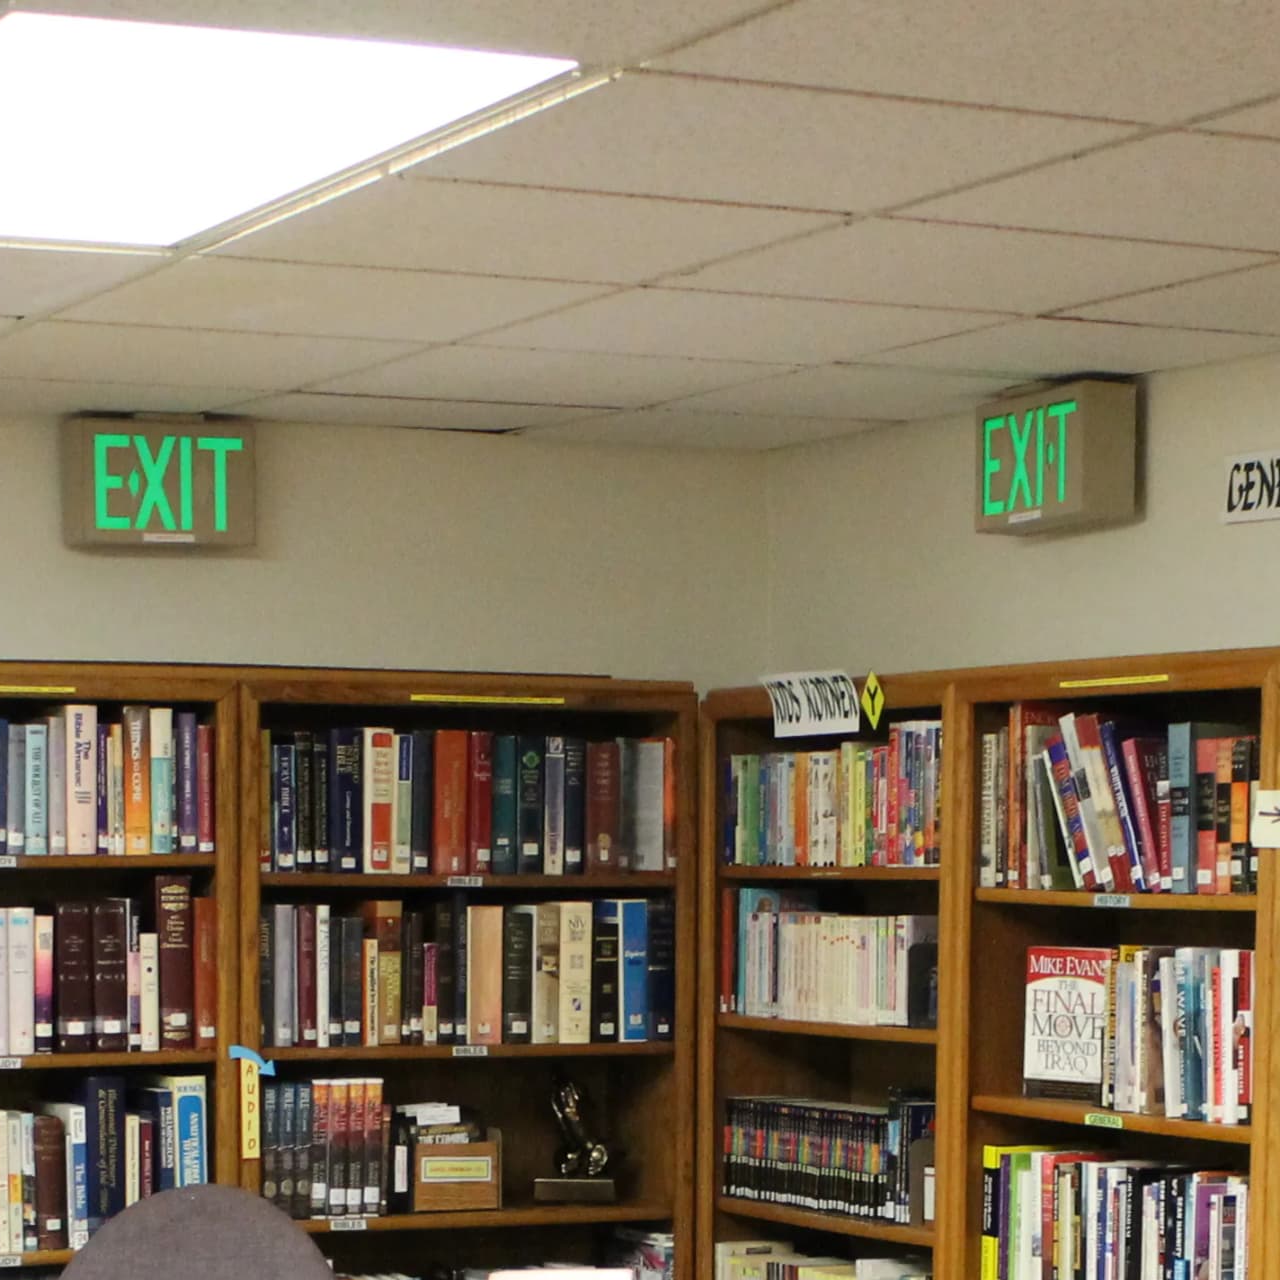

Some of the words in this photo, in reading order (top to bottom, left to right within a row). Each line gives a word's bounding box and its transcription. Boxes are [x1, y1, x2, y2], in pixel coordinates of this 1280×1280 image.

[983, 400, 1076, 516] EXIT
[95, 435, 243, 531] EXIT
[768, 681, 801, 724] KIDS
[803, 675, 858, 720] KORNER
[866, 685, 879, 717] Y
[74, 713, 83, 738] Bible
[130, 720, 142, 759] THINGS
[74, 741, 83, 787] Almanac
[280, 757, 290, 783] HOLY
[131, 772, 141, 803] COME
[280, 787, 290, 814] BIBLE
[1158, 806, 1167, 821] THE
[1158, 825, 1166, 848] CIVIL
[1158, 851, 1166, 870] WAR
[1097, 896, 1127, 906] HISTORY
[1030, 955, 1063, 973] MIKE
[1032, 990, 1104, 1015] FINAL
[1176, 991, 1187, 1037] WAVE
[1032, 1014, 1104, 1038] MOVE
[1037, 1038, 1096, 1056] BEYOND
[1044, 1055, 1089, 1075] IRAQ
[246, 1063, 258, 1151] AUDIO
[75, 1163, 86, 1180] The
[75, 1183, 86, 1209] Bible
[1176, 1197, 1184, 1215] SEAN
[1174, 1217, 1183, 1257] HANNITY
